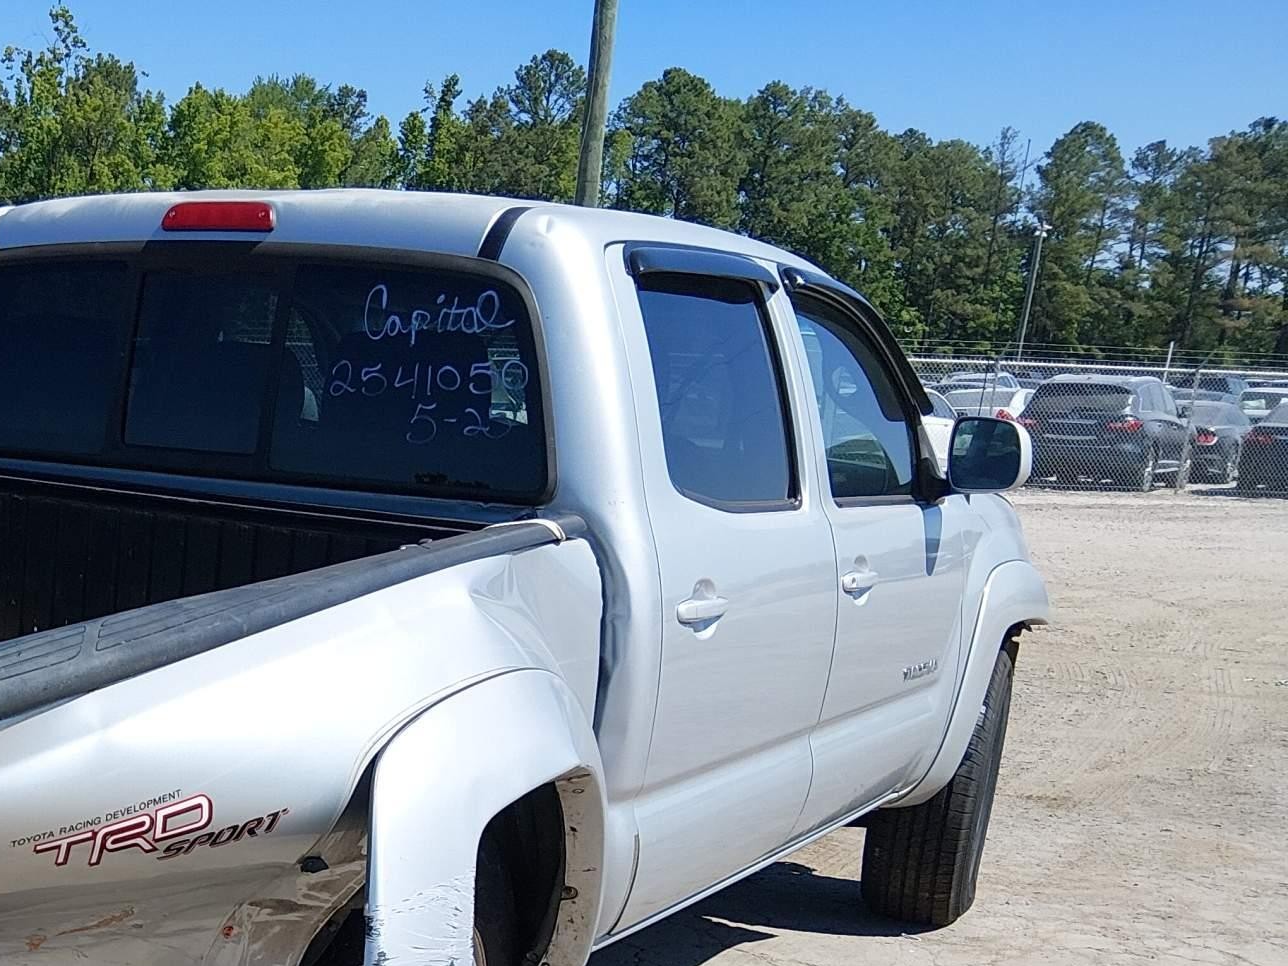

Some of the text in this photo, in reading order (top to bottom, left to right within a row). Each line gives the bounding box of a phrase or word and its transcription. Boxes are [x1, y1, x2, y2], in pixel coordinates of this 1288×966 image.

[329, 360, 528, 399] 2541050
[11, 788, 183, 848] TOYOTA RACING DEVELOPMENT
[32, 793, 214, 867] TRD
[156, 807, 290, 860] SPORT
